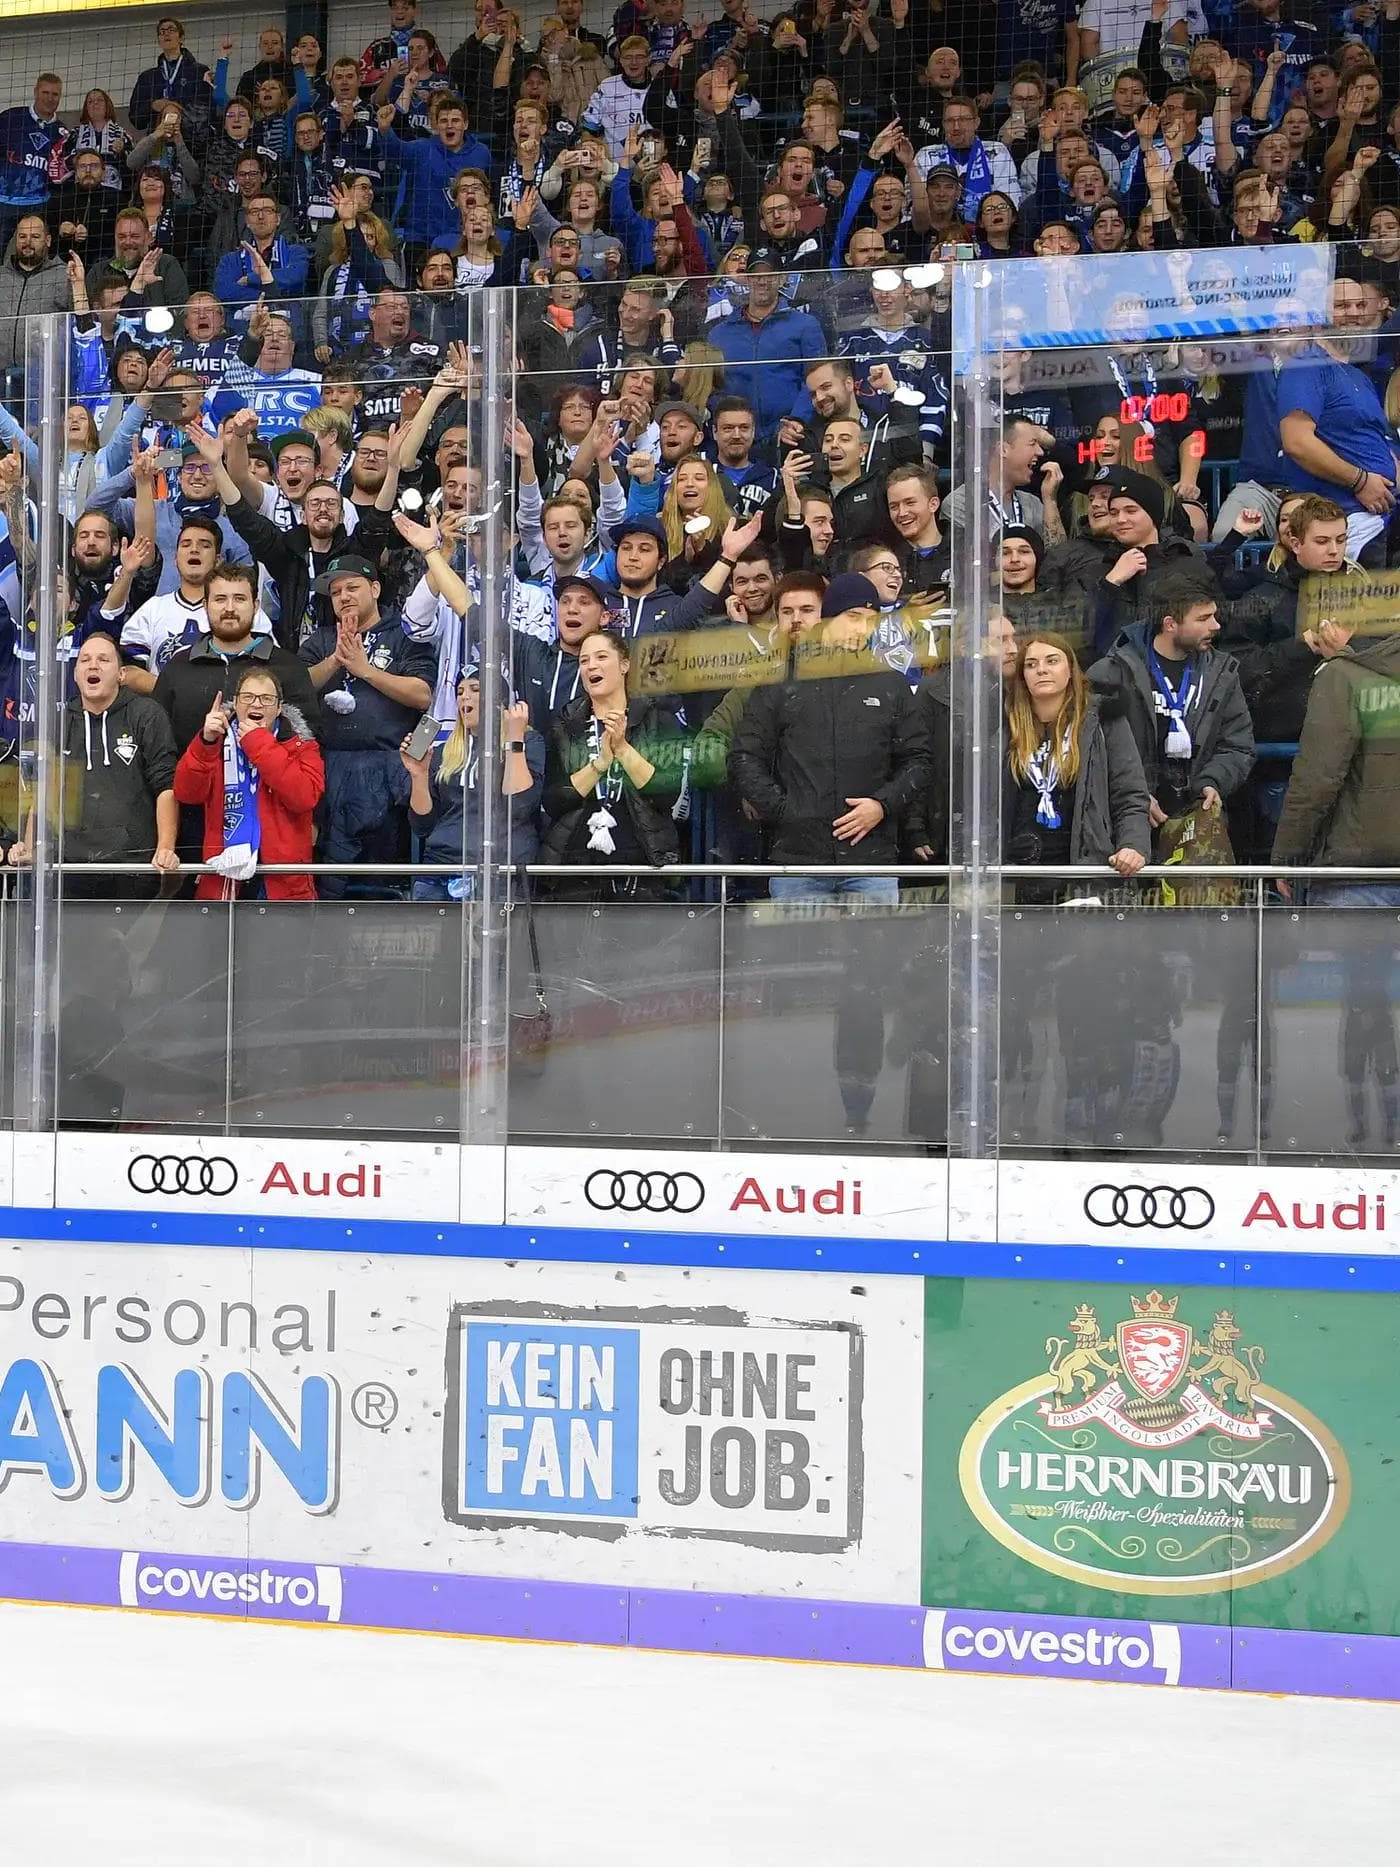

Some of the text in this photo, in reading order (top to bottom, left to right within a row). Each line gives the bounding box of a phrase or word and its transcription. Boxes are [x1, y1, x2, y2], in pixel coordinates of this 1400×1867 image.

[259, 1161, 383, 1199] Audi
[728, 1176, 862, 1216] Audi
[1240, 1191, 1387, 1232] Audi
[486, 1339, 817, 1422] KEIN OHNE
[1052, 1386, 1118, 1426] PREMIUM
[1191, 1391, 1253, 1436] BAVARIA
[1102, 1410, 1202, 1445] INGOLSTADT
[486, 1413, 831, 1514] FAN JOB.
[996, 1449, 1313, 1505] HERRNBRÄU
[1053, 1499, 1246, 1530] Weißbier-Spezialitäten
[137, 1564, 316, 1606] covestro
[945, 1624, 1150, 1669] covestro
